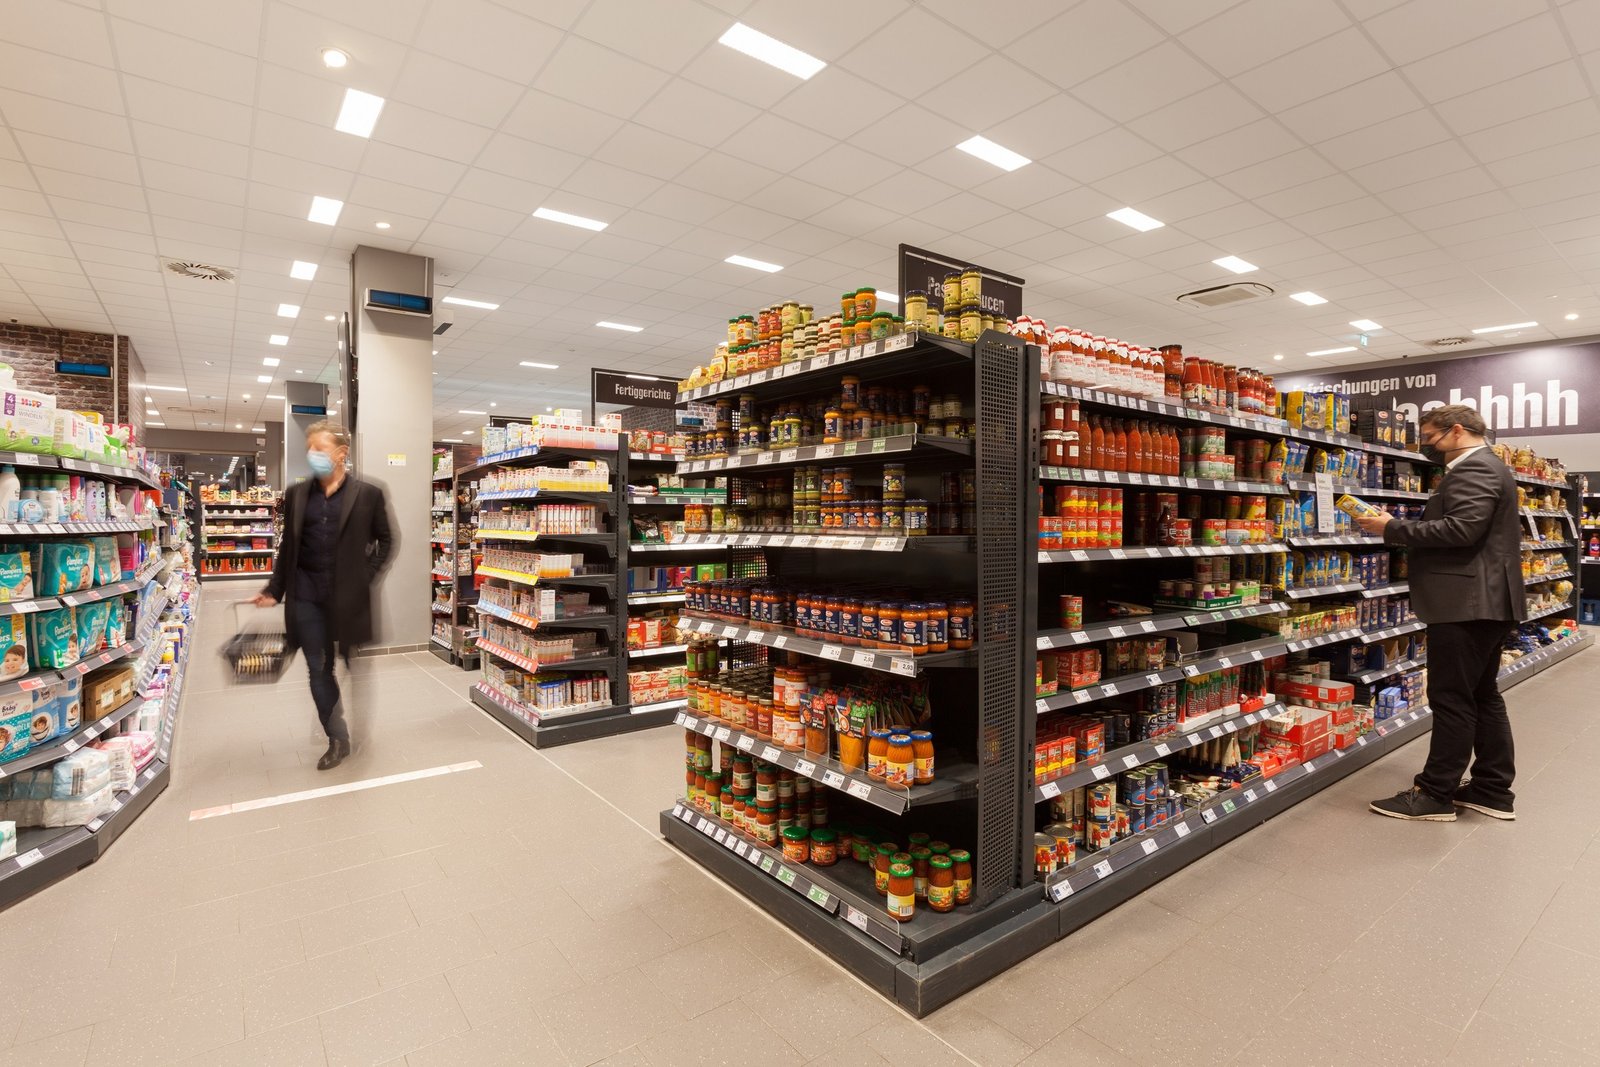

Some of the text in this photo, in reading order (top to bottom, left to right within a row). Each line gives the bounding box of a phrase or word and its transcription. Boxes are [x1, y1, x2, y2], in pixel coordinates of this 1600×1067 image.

[927, 276, 945, 299] Pas
[1404, 373, 1438, 389] von
[615, 383, 672, 400] Fertiggerichte
